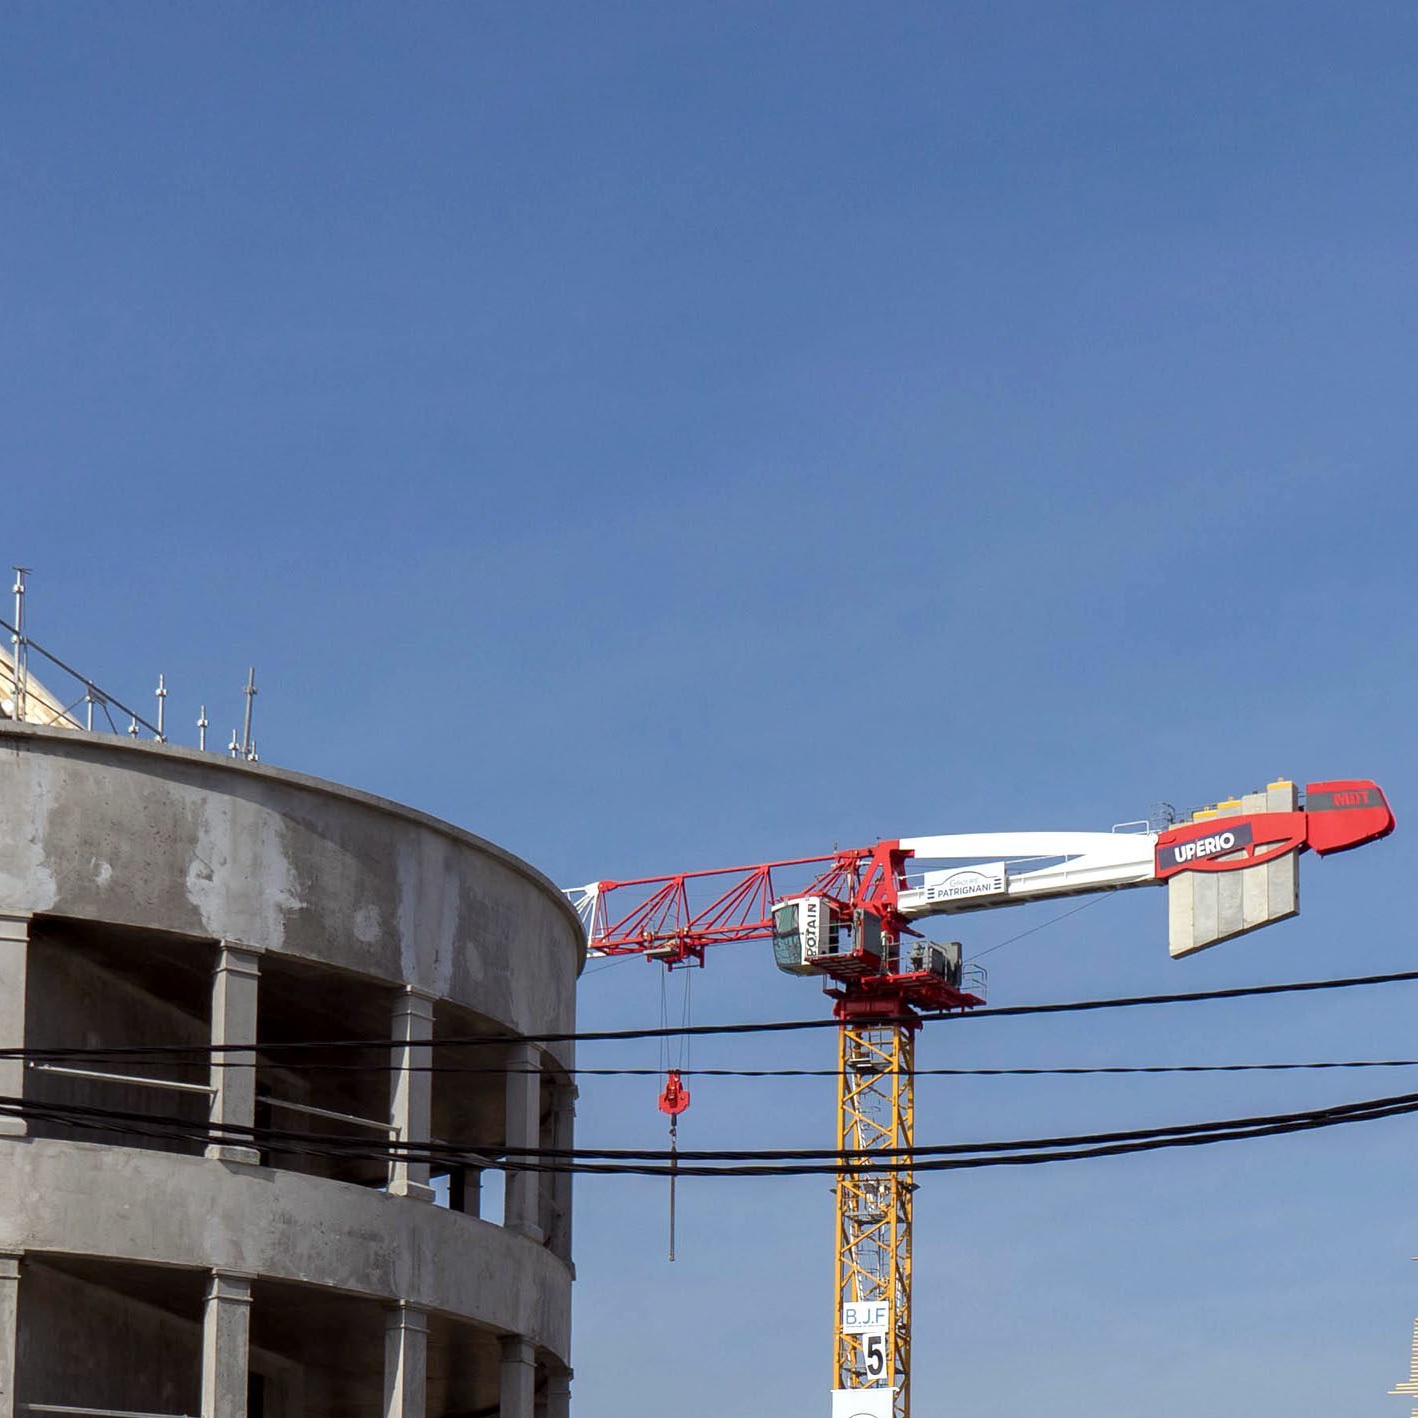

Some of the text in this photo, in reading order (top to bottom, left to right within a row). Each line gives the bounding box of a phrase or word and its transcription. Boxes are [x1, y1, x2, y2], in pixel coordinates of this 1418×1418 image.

[1174, 832, 1235, 863] UPERIO
[937, 884, 991, 898] PATRIGNANI
[807, 903, 817, 957] POTAIN
[845, 1308, 886, 1325] B.J.F
[867, 1335, 884, 1376] 5
